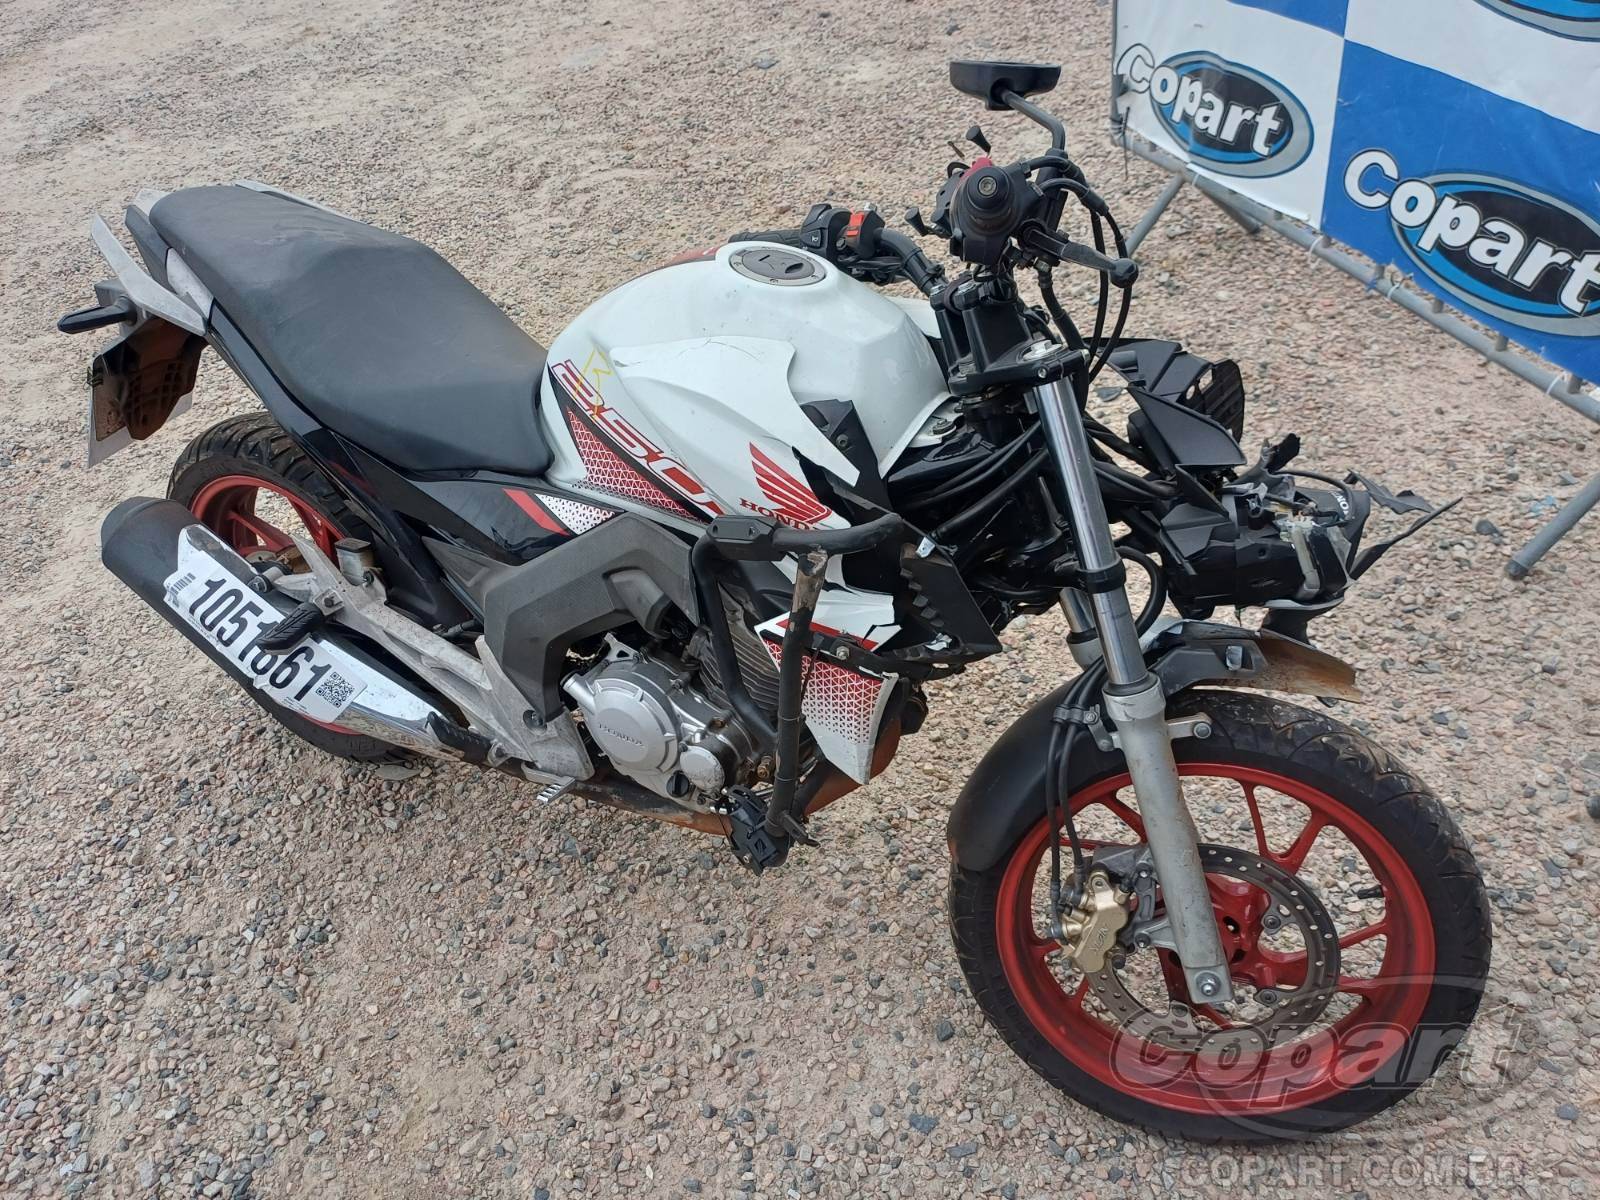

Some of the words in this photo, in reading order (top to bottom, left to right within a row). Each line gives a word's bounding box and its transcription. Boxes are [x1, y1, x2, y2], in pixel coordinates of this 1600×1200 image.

[1116, 43, 1285, 157] Copart
[1344, 149, 1600, 317] Copart
[740, 497, 820, 531] HOND
